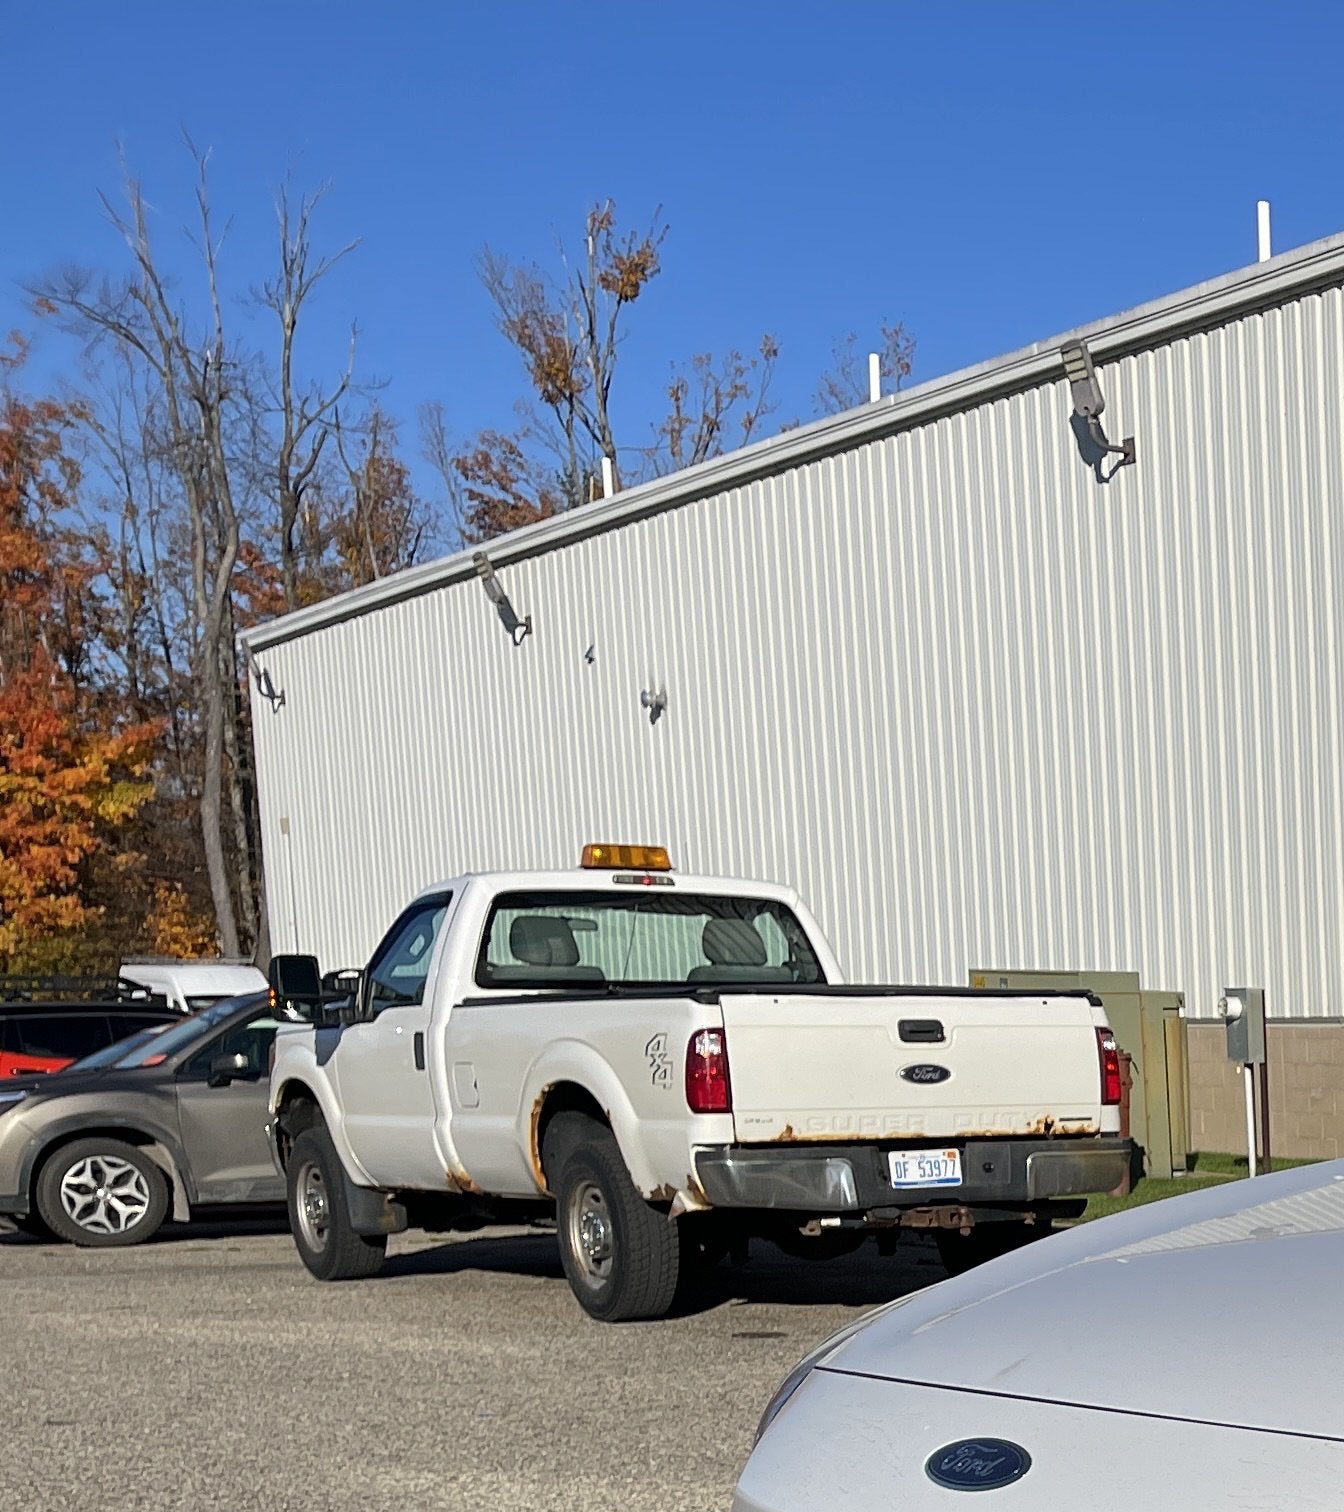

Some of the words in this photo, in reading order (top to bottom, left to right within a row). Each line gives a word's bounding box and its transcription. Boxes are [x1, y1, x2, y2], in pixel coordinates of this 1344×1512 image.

[912, 1066, 941, 1080] Ford
[917, 1159, 956, 1178] 53977
[940, 1443, 1006, 1477] Ford
